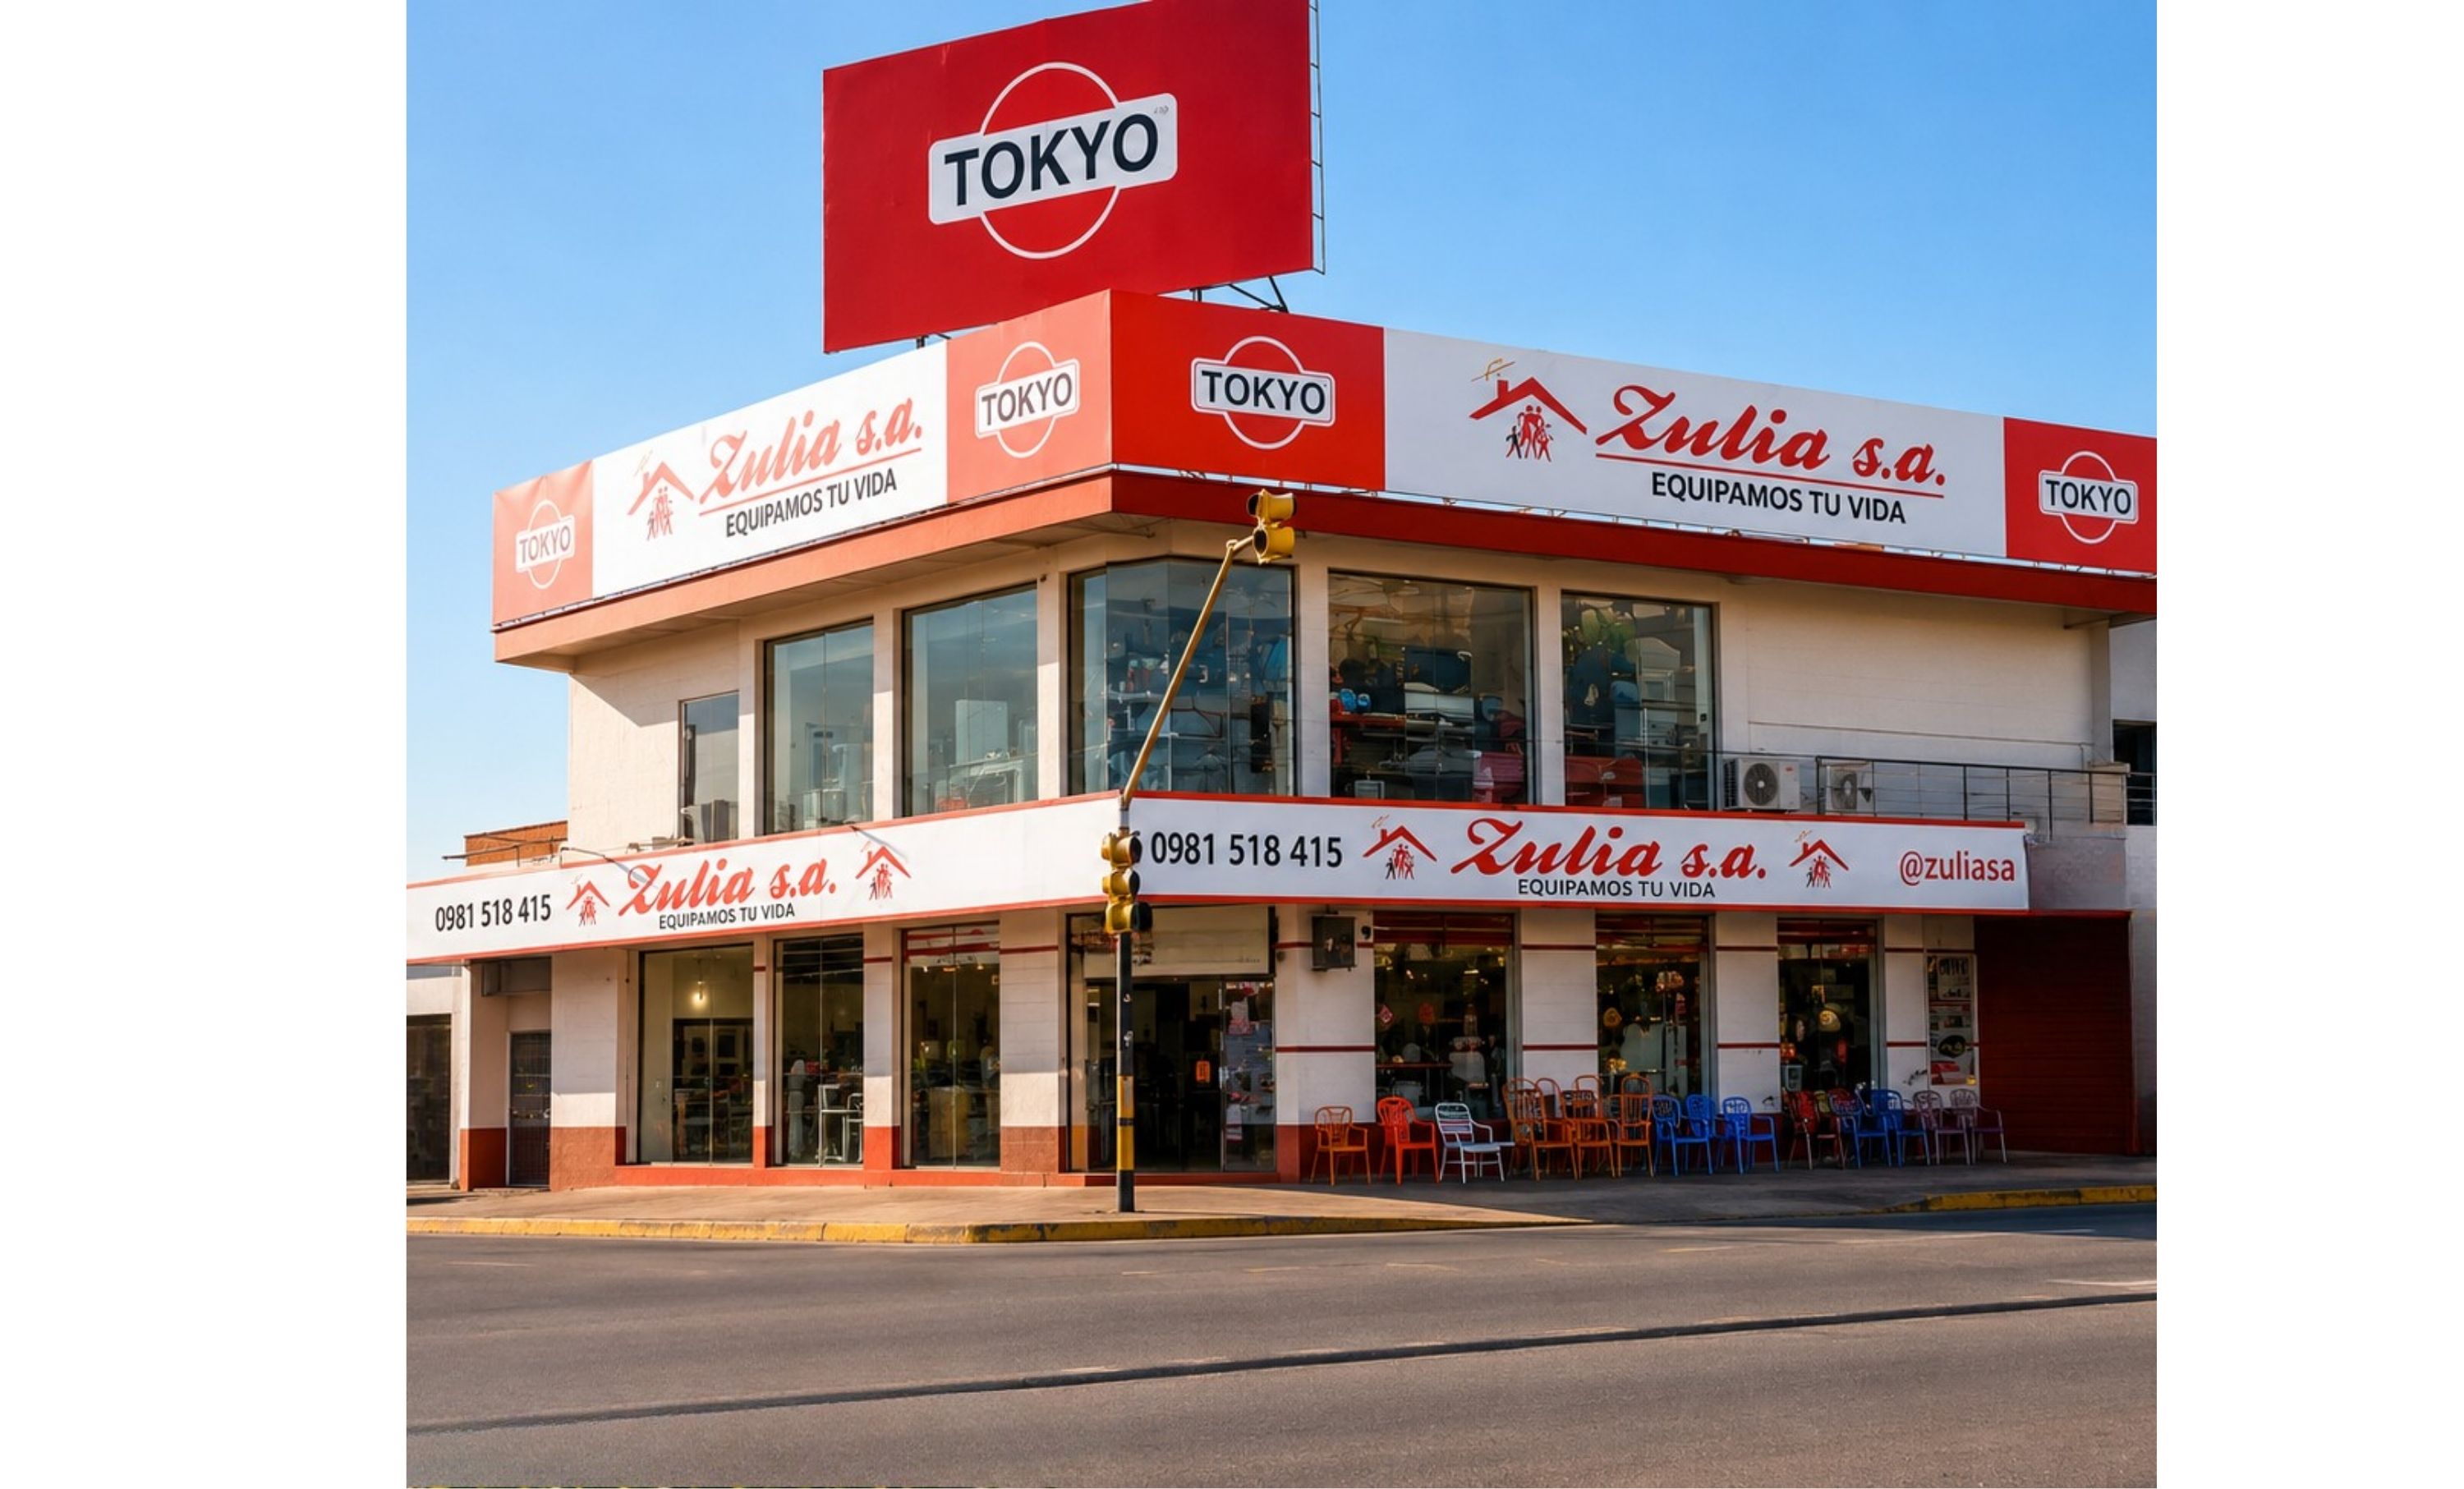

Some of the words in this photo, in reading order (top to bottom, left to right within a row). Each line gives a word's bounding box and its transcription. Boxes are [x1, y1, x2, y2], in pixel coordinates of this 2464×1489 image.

[945, 114, 1157, 205] TOKYO
[982, 373, 1072, 425] TOKYO
[1202, 370, 1325, 414] TOKYO
[700, 410, 843, 503] Zulia
[856, 398, 922, 453] s.a.
[1596, 385, 1830, 468] Zulia
[1853, 439, 1945, 485] s.a.
[727, 489, 822, 537] EQUIPAMOS
[827, 480, 848, 508] TU
[854, 468, 897, 499] VIDA
[1653, 472, 1802, 512] EQUIPAMOS
[1809, 491, 1840, 516] TU
[1848, 495, 1905, 523] VIDA
[2046, 480, 2131, 514] TOKYO
[519, 530, 572, 564] TOKYO
[1152, 832, 1213, 864] 0981
[1230, 834, 1280, 866] 518
[1290, 836, 1342, 867] 415
[1451, 819, 1662, 876] Zulia
[1681, 844, 1766, 879] s.a.
[1901, 851, 2014, 885] @zuliasa
[618, 858, 754, 917] Zulia
[770, 859, 835, 899] s.a.
[1519, 879, 1632, 896] EQUIPAMOS
[1639, 881, 1662, 897] TU
[1670, 882, 1715, 897] VIDA
[435, 903, 474, 932] 0981
[482, 898, 512, 926] 518
[518, 894, 550, 922] 415
[660, 908, 736, 930] EQUIPAMOS
[740, 907, 756, 921] TU
[761, 903, 795, 919] VIDA
